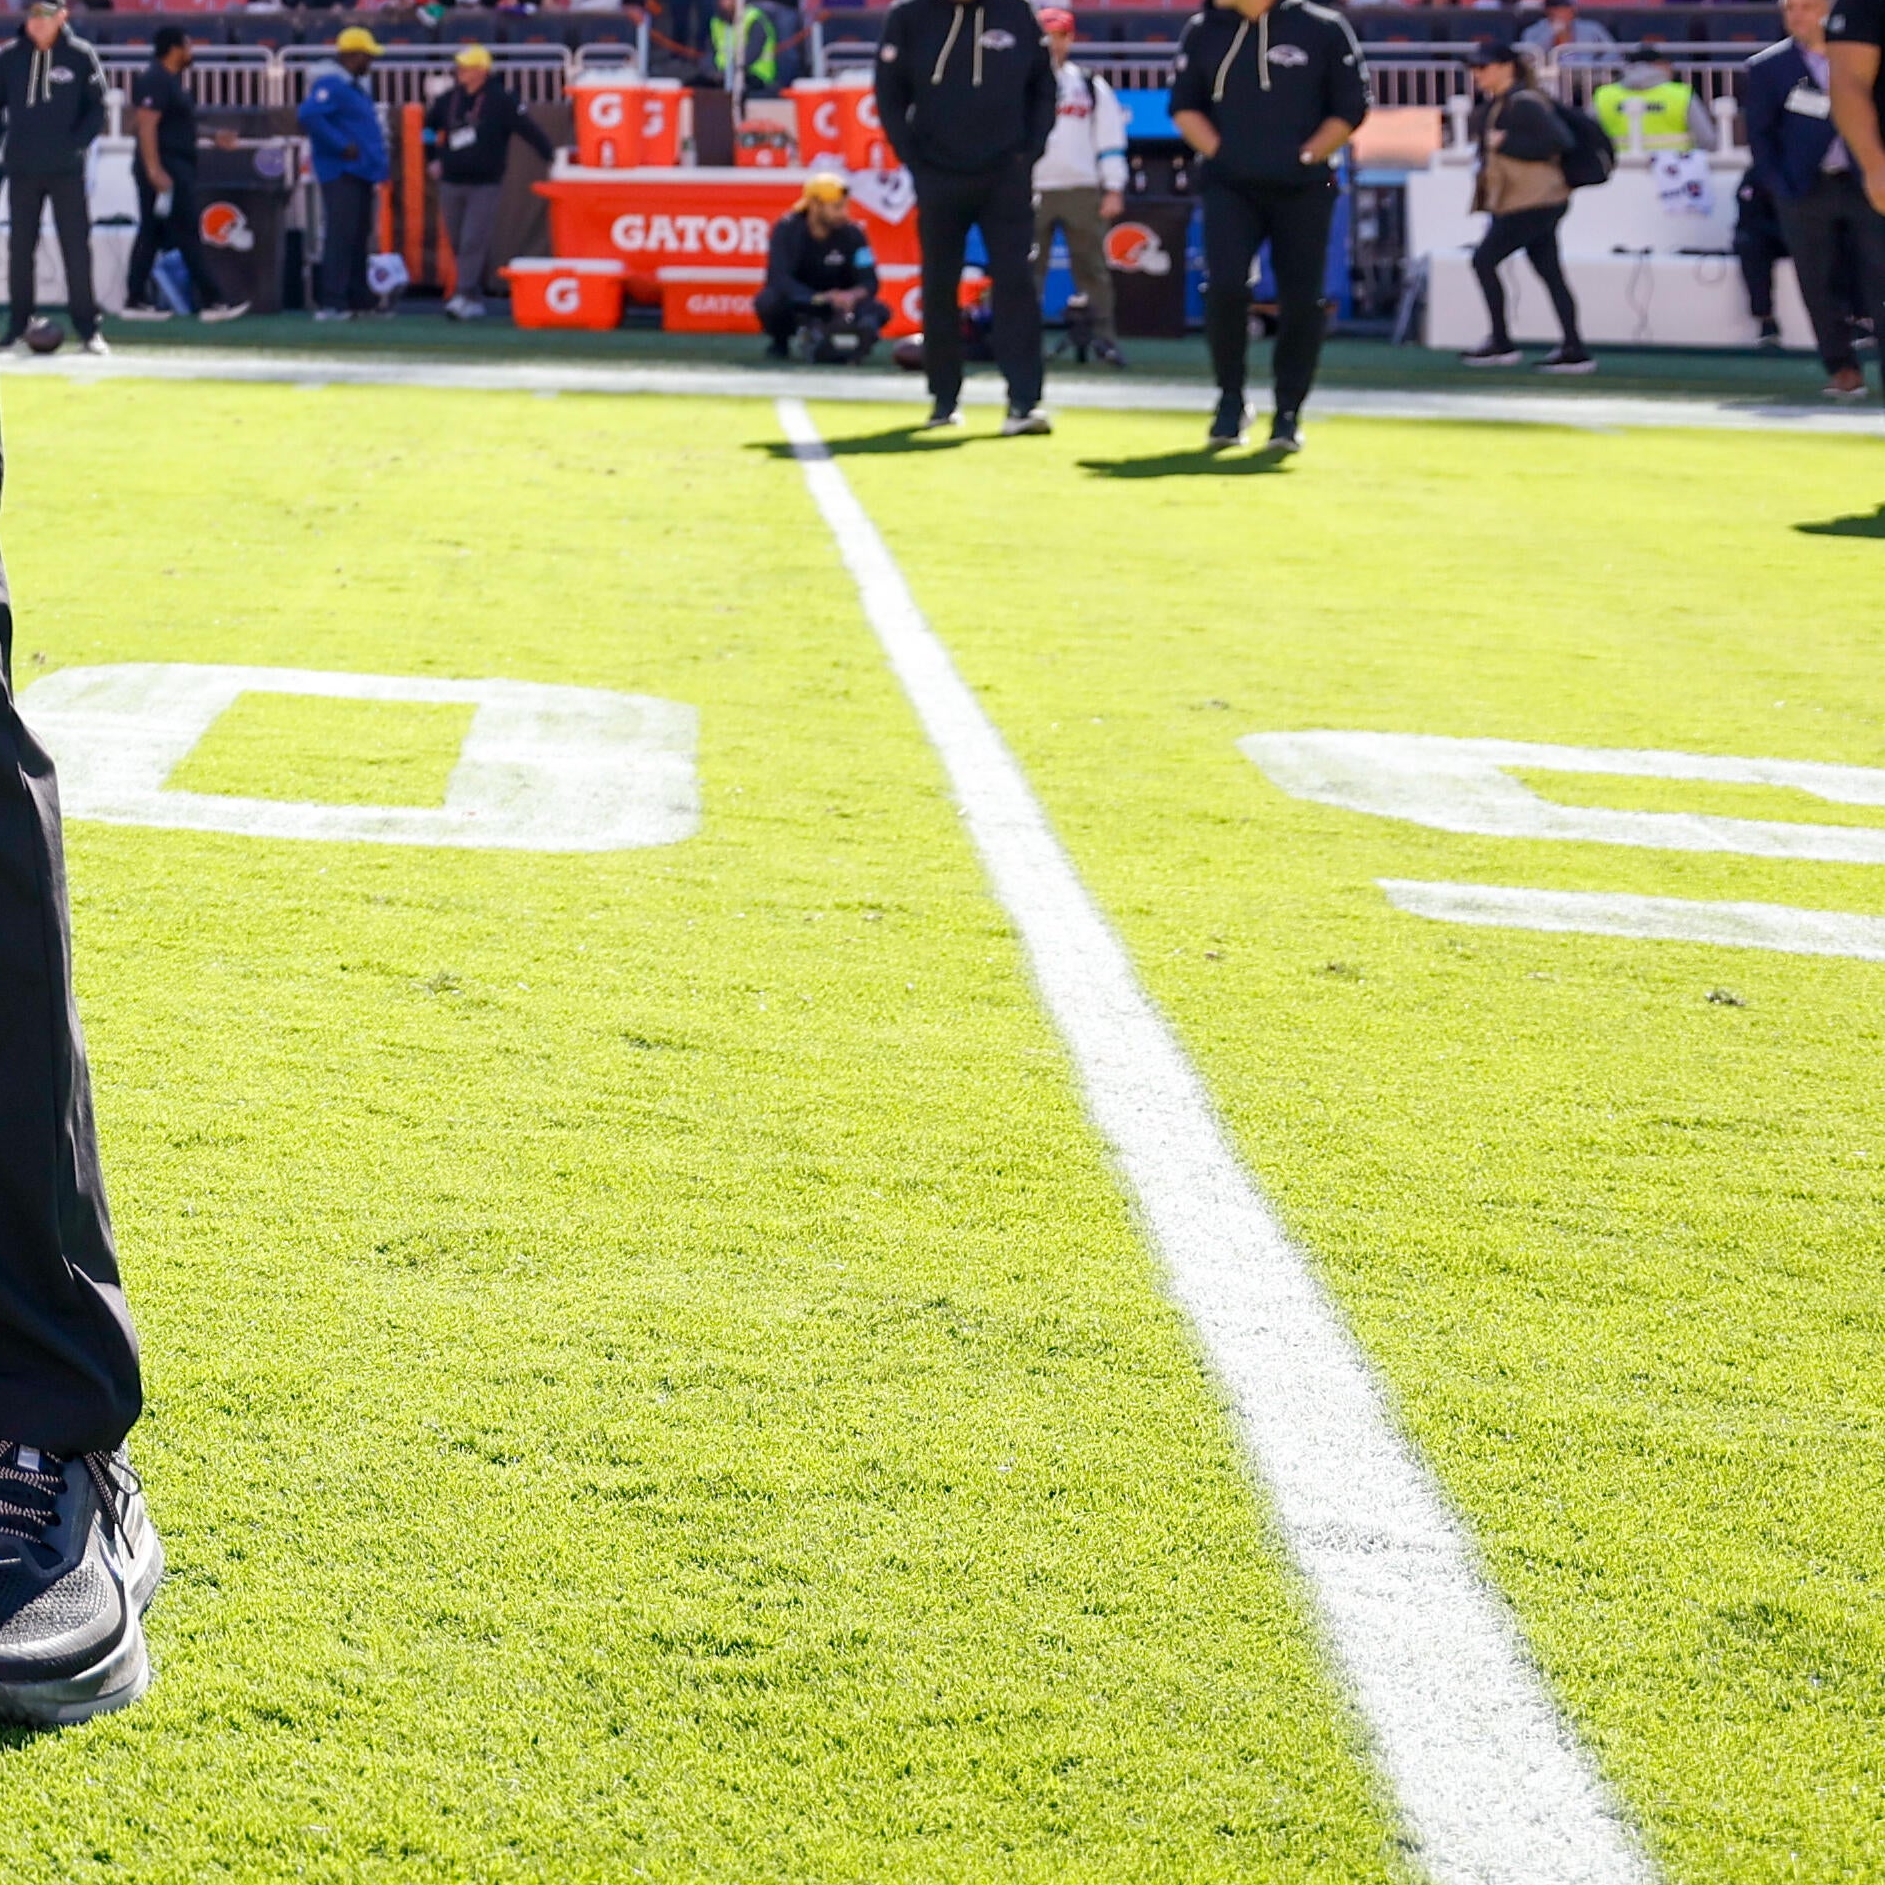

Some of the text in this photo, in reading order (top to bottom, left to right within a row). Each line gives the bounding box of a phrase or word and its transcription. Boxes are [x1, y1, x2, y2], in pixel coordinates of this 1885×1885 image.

[589, 92, 623, 128] G
[611, 213, 770, 255] GATOR
[545, 277, 582, 314] G
